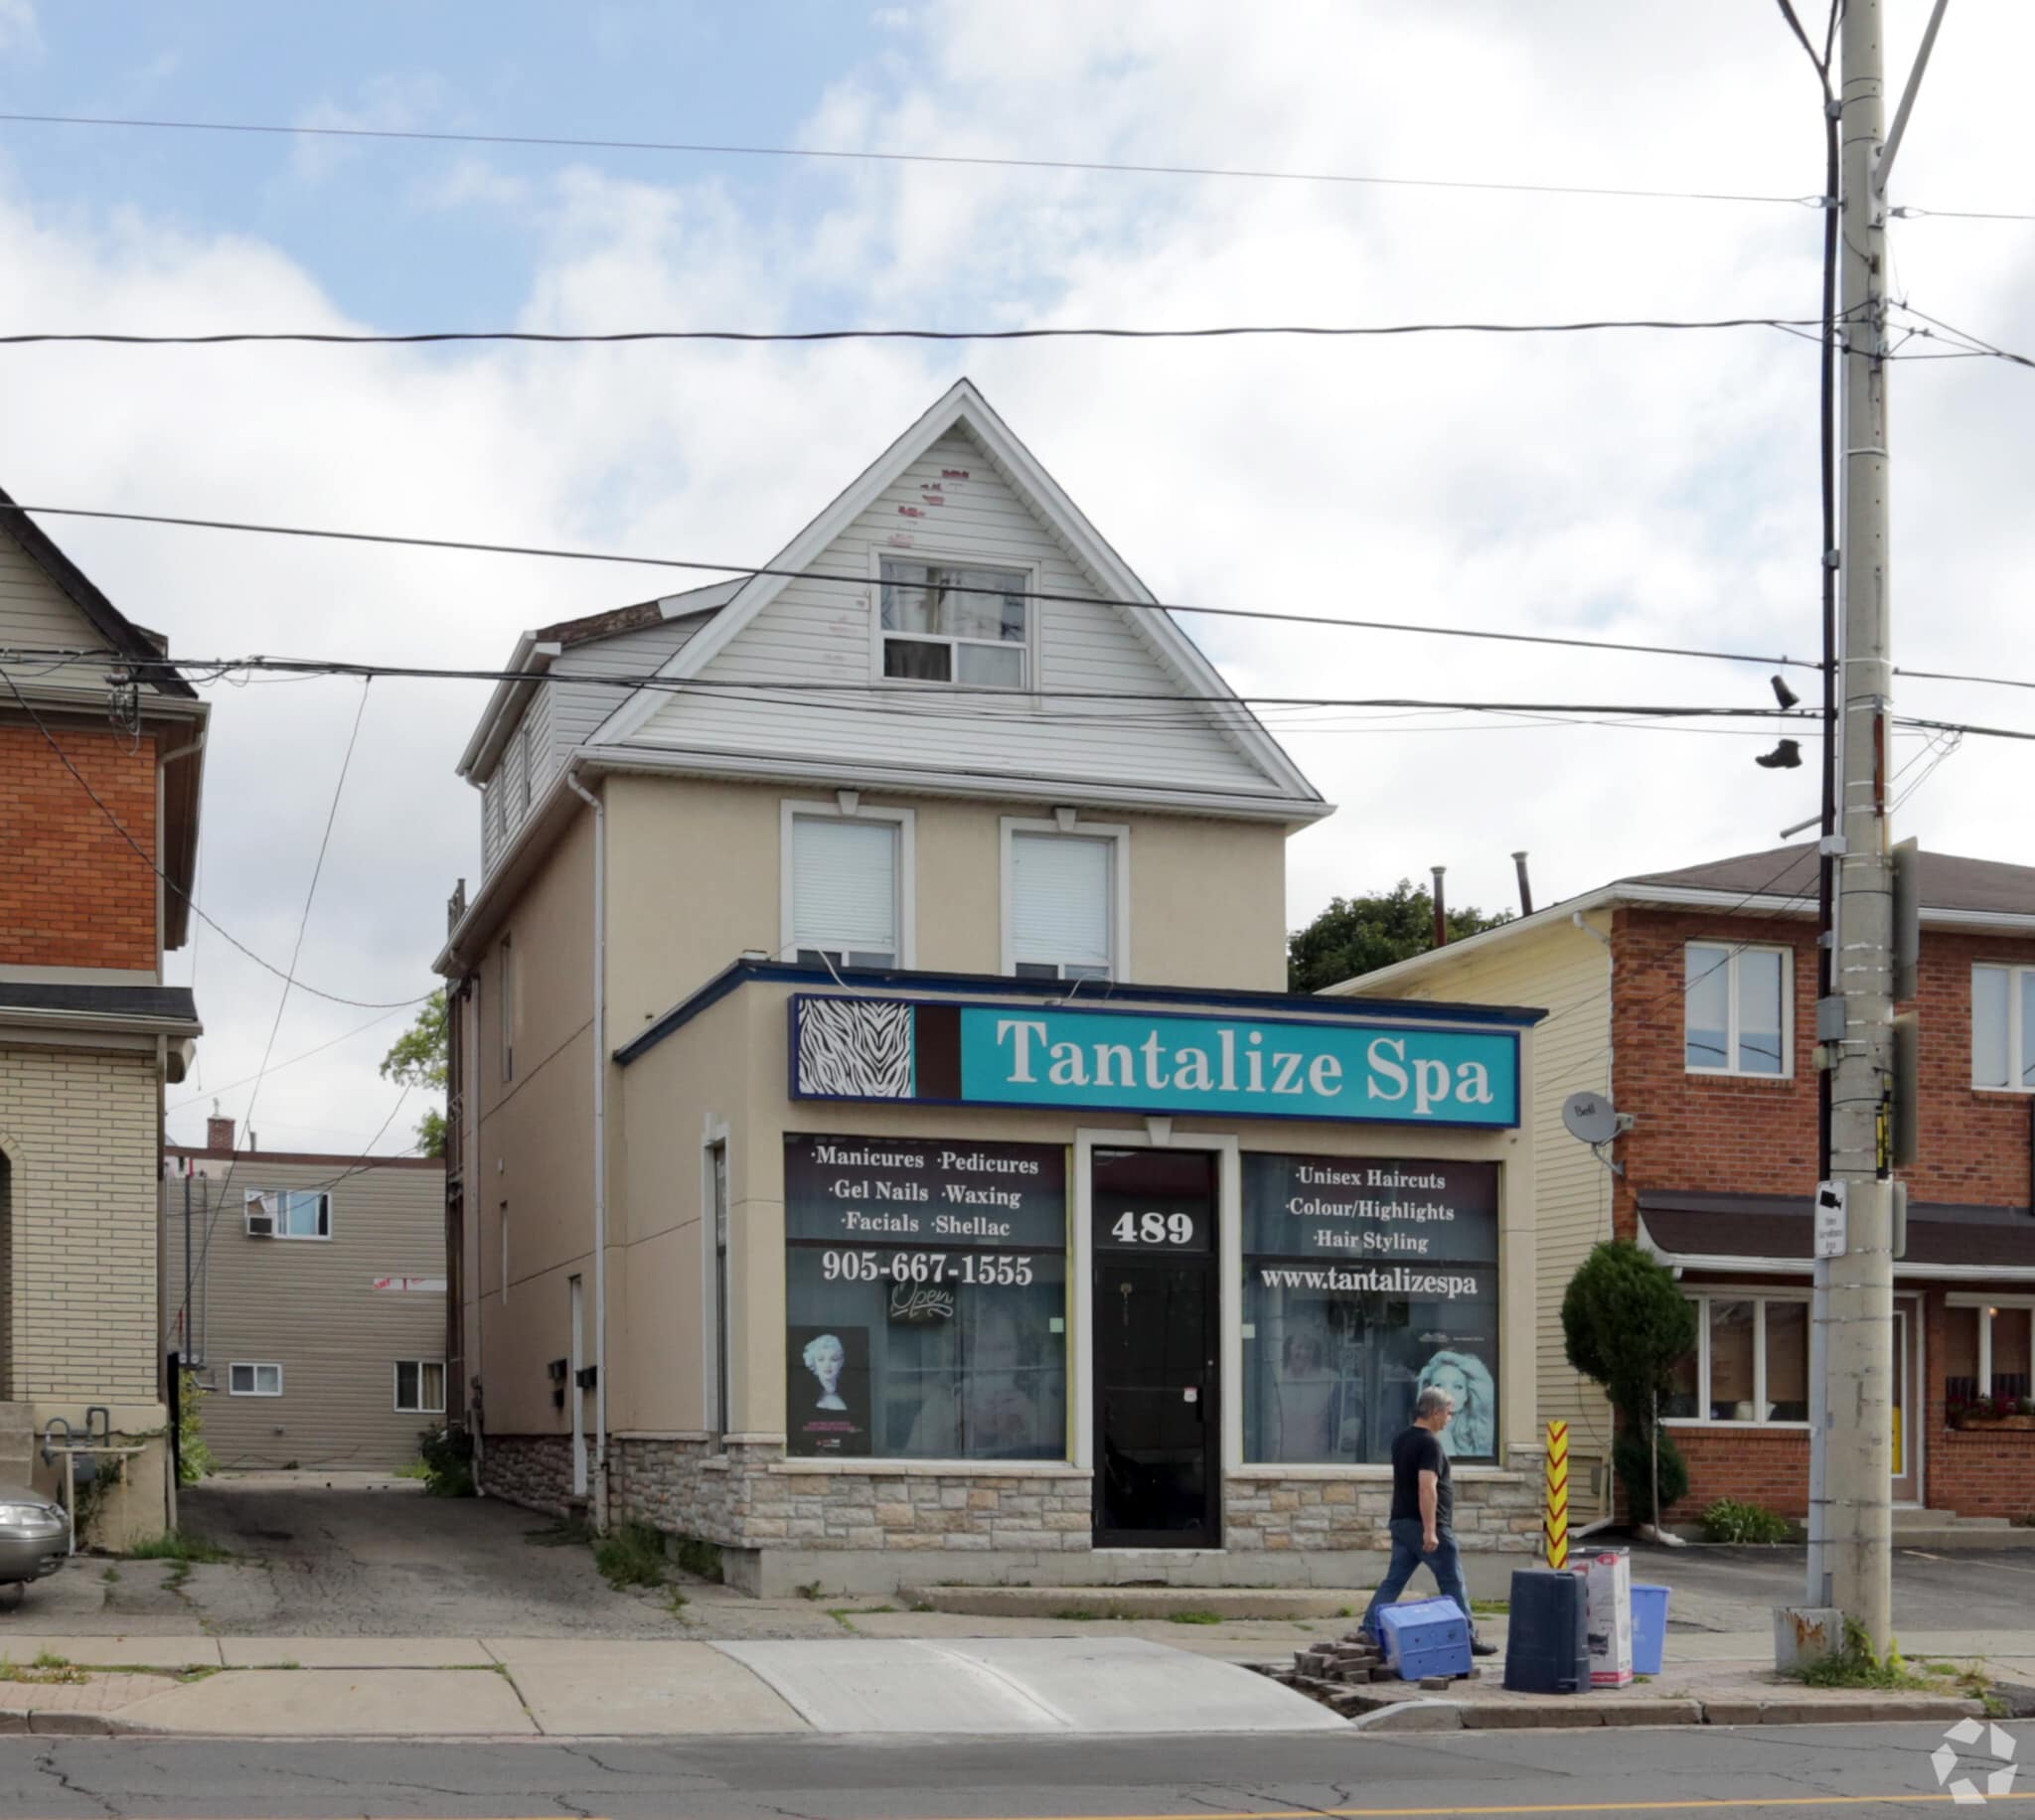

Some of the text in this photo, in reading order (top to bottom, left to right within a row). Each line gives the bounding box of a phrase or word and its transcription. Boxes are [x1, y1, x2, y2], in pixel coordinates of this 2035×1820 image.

[998, 1019, 1493, 1115] Tantalize Spa
[1574, 1102, 1596, 1118] Bell
[816, 1145, 1038, 1174] Manicures Pedicures
[1299, 1166, 1446, 1189] Unisex Haircuts
[835, 1179, 1021, 1209] Gel Nails Waxing
[846, 1211, 1011, 1236] Facials Shellac
[1290, 1197, 1455, 1223] Colour/Highlights
[1112, 1212, 1193, 1244] 489
[1317, 1230, 1429, 1254] Hair Styling
[823, 1251, 1032, 1286] 905-667-1555
[1261, 1267, 1478, 1298] www.tantalizespa
[891, 1281, 954, 1318] Open
